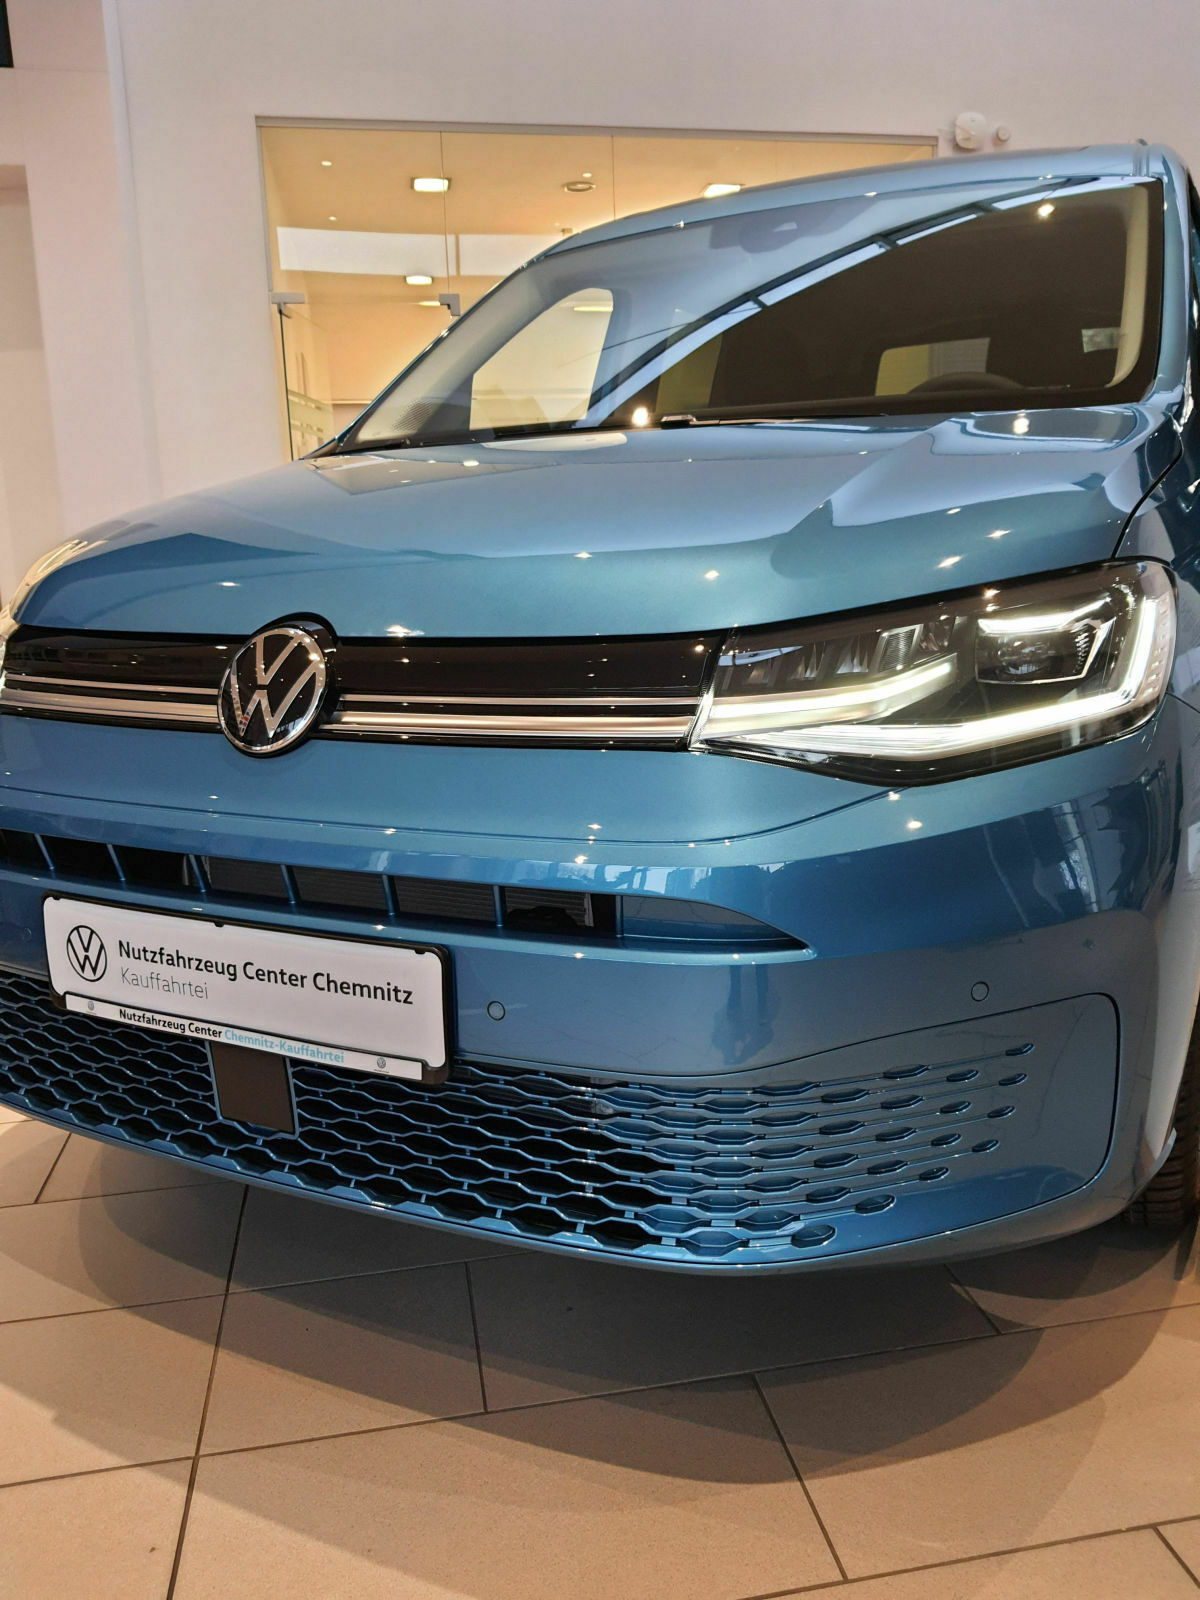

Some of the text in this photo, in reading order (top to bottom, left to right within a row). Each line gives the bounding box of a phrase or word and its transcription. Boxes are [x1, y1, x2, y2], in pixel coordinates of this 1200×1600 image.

[118, 939, 413, 1005] Nutzfahrzeug Center Chemnitz
[120, 966, 208, 1000] Kauffahrtei
[119, 1008, 344, 1063] Nutzfahrzeug Center Chemnitz-Kauffahrtei
